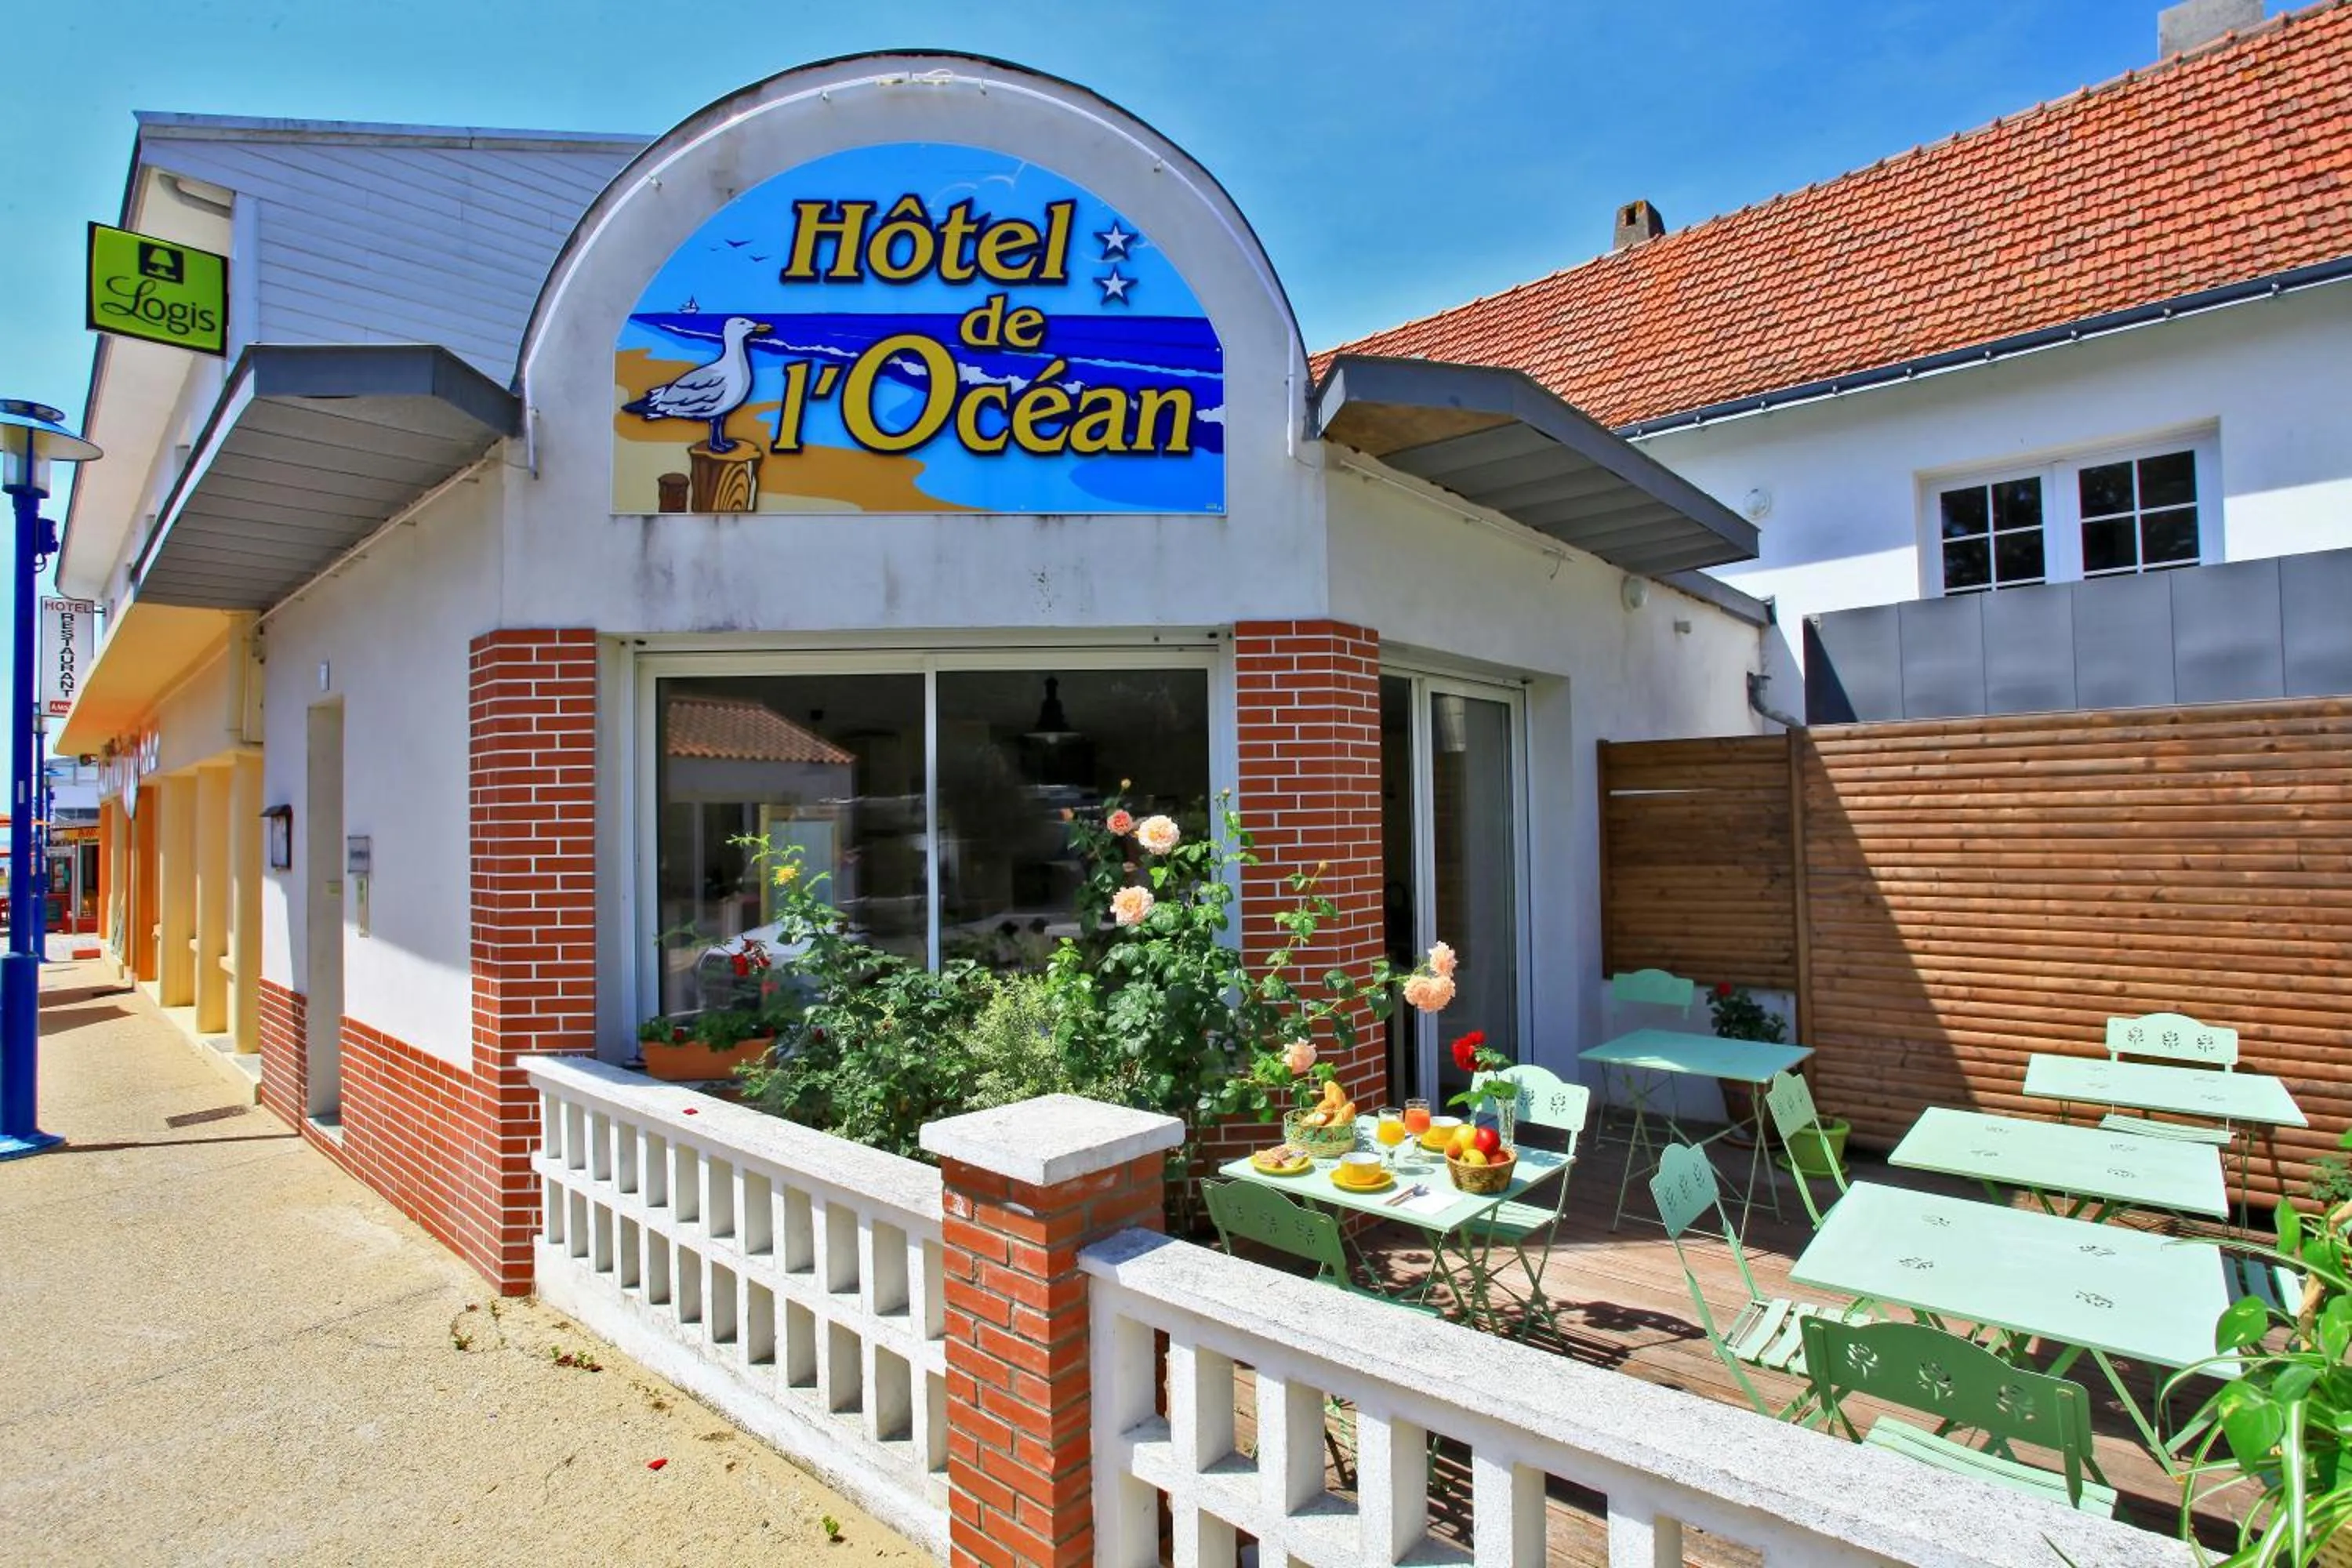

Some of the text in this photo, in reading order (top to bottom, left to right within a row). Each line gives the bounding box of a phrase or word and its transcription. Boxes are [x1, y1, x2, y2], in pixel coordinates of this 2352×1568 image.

[782, 195, 1075, 283] Hôtel
[100, 276, 216, 336] Logis
[960, 296, 1045, 350] de
[771, 333, 1195, 456] l'Océan
[45, 600, 92, 613] HOTEL
[60, 613, 75, 697] RESTAURANT
